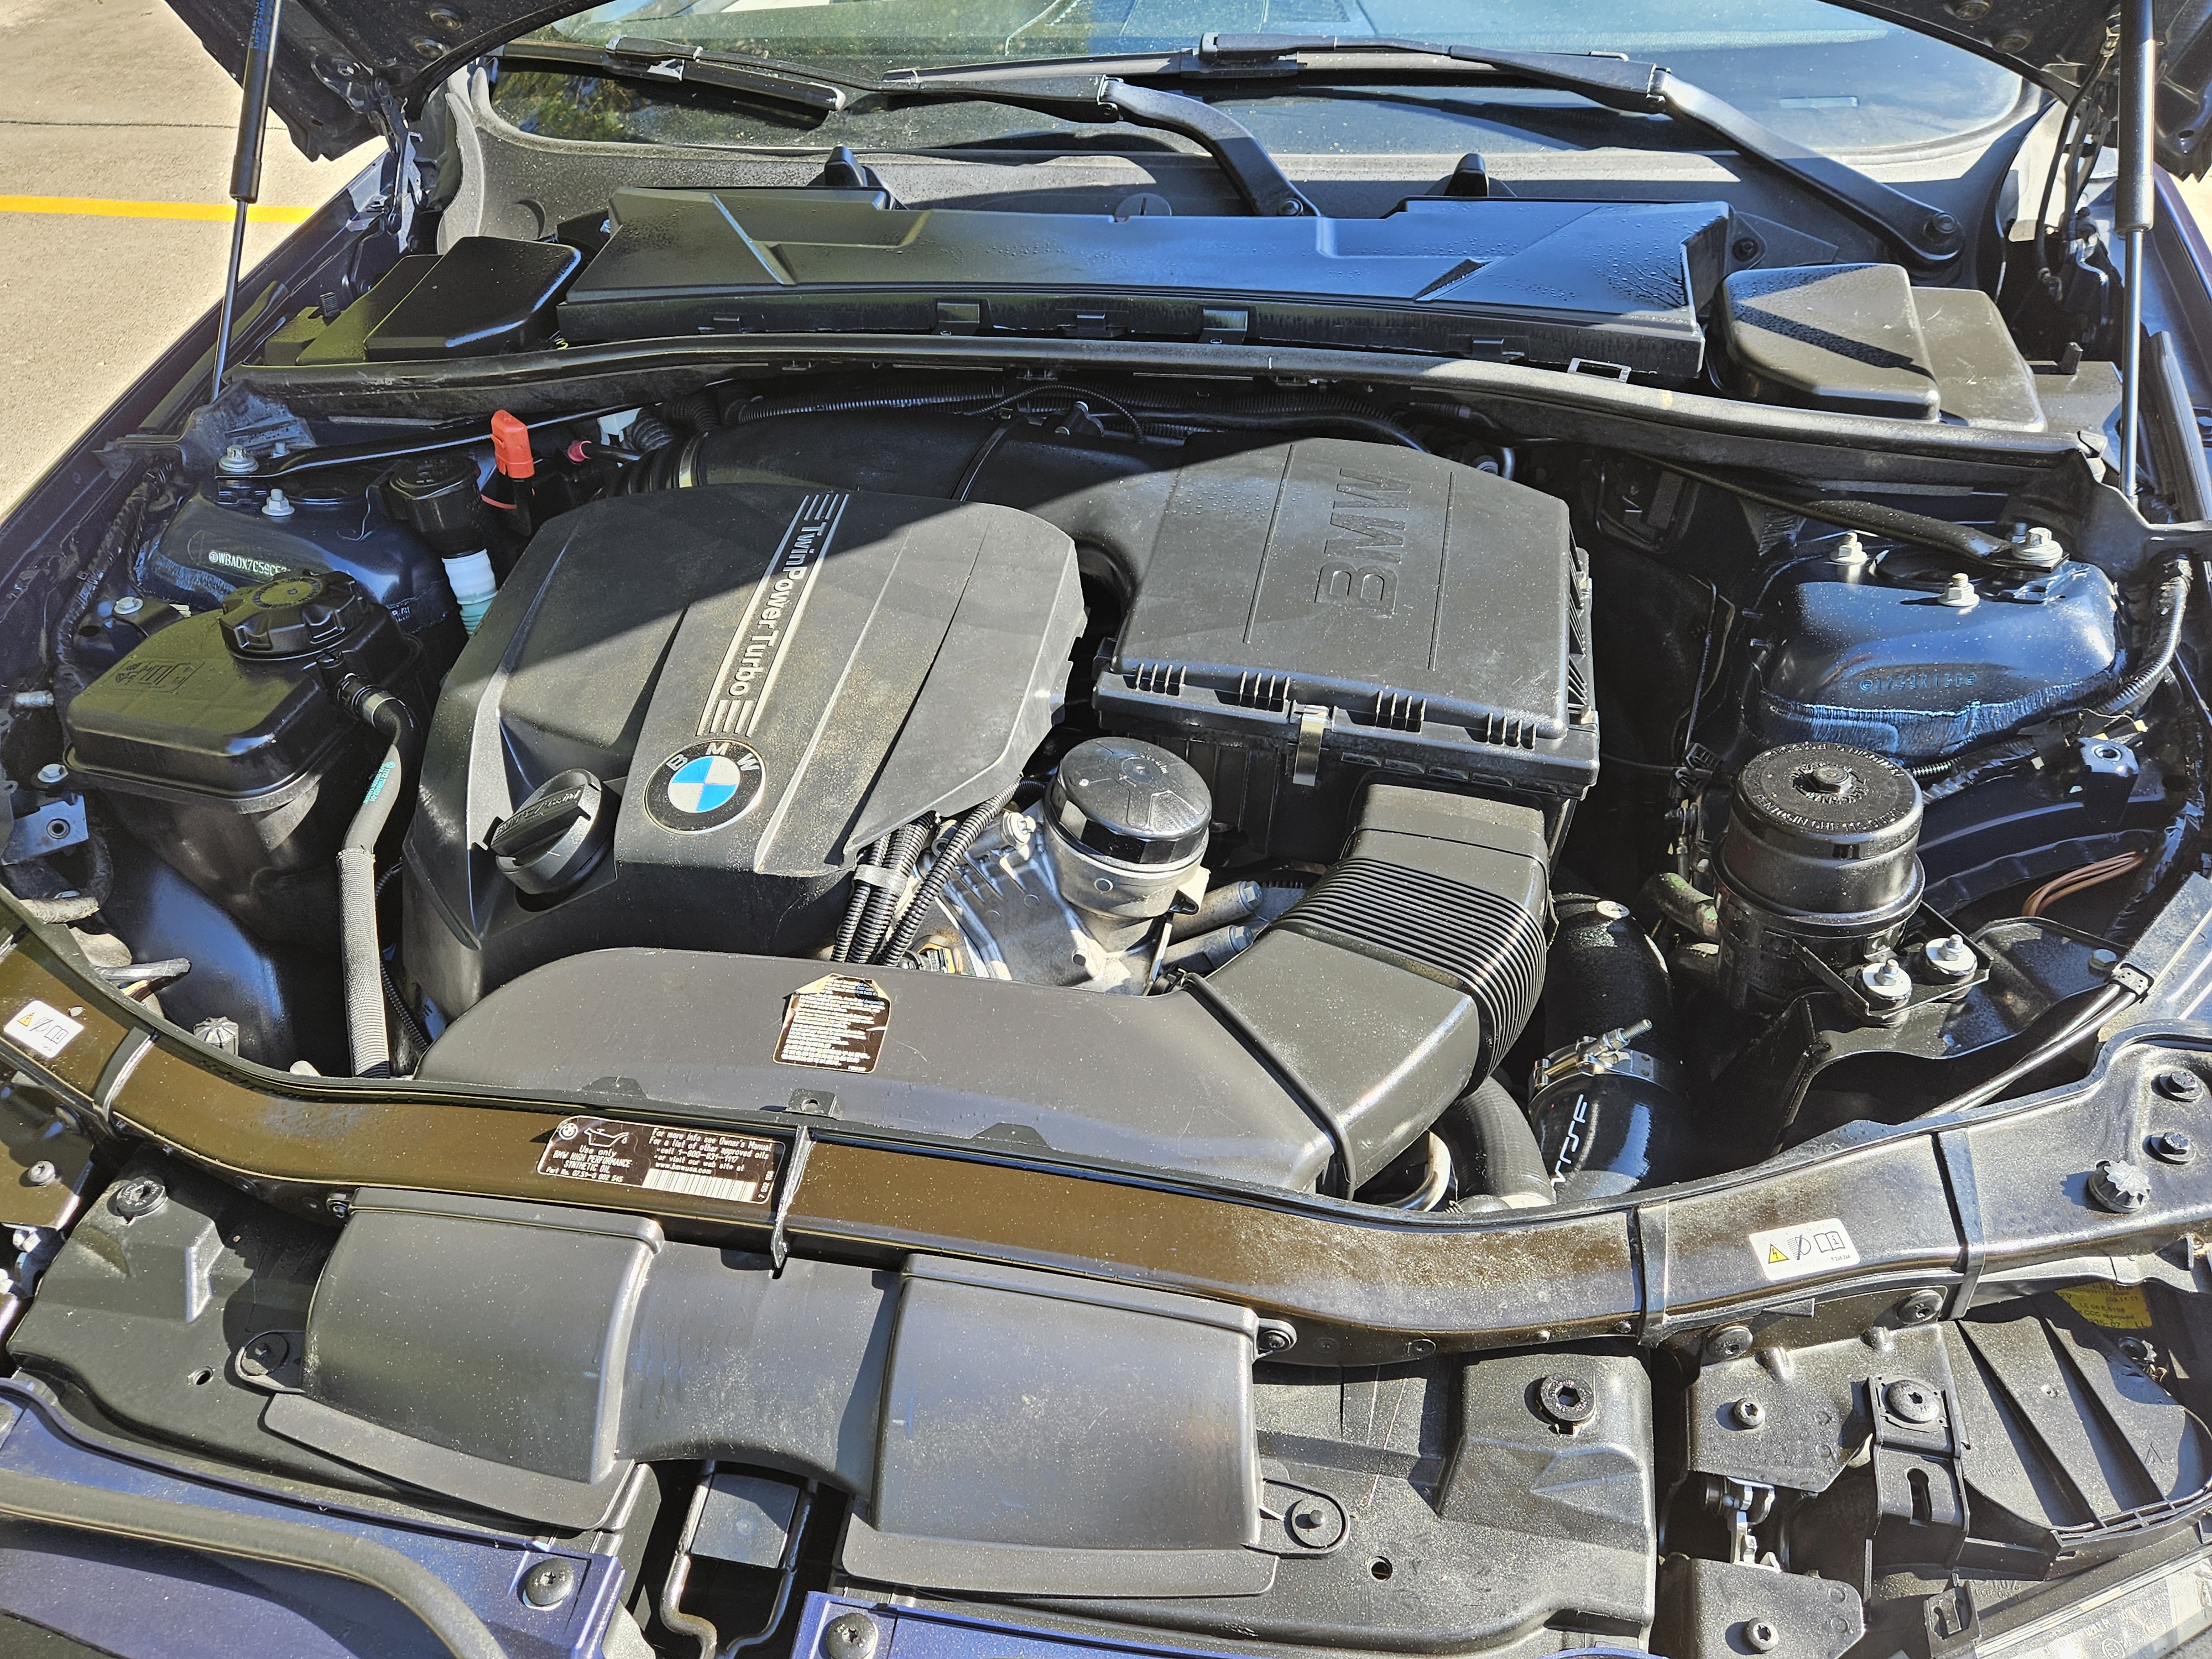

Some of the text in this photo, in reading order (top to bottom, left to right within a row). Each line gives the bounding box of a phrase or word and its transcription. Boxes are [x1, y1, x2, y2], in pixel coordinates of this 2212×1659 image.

[1314, 468, 1411, 614] BMW
[665, 742, 760, 772] BMW
[1752, 794, 1809, 826] PENTOSIN
[649, 1136, 661, 1145] For
[672, 1139, 686, 1148] list
[699, 1144, 718, 1152] other
[720, 1147, 753, 1158] approved
[754, 1151, 769, 1160] oils
[652, 1128, 665, 1137] For
[686, 1133, 701, 1142] info
[719, 1136, 745, 1148] Owner's
[748, 1140, 773, 1152] Manual
[553, 1150, 632, 1168] BMW HIGH PERFORMANCE
[579, 1145, 617, 1158] Use only
[564, 1160, 611, 1173] SYNTHETIC OIL
[655, 1162, 712, 1175] www.bmwusa.com
[760, 1182, 770, 1193] 502
[2103, 1313, 2135, 1322] approved
